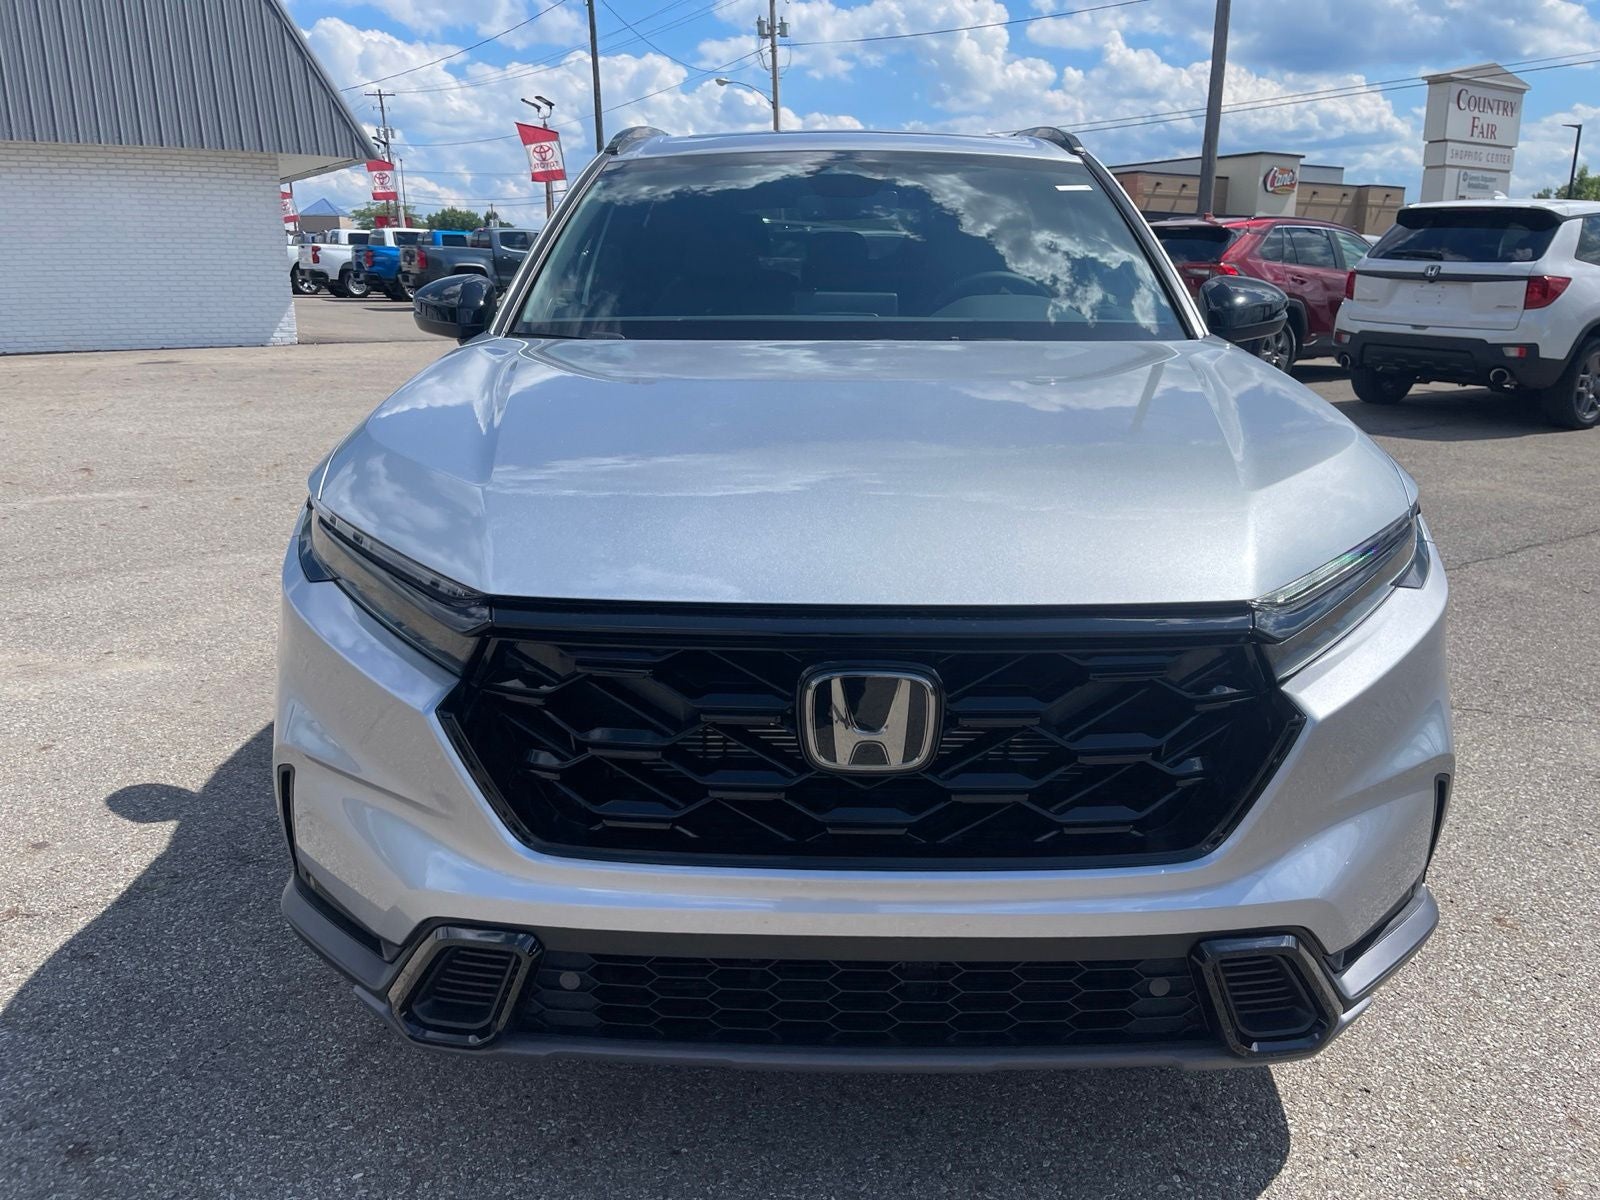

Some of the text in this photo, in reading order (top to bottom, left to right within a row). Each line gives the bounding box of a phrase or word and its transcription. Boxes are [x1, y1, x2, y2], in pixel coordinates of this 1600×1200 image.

[1457, 89, 1516, 117] COUNTRY
[1470, 116, 1497, 139] FAIR
[1486, 152, 1511, 165] CENTER
